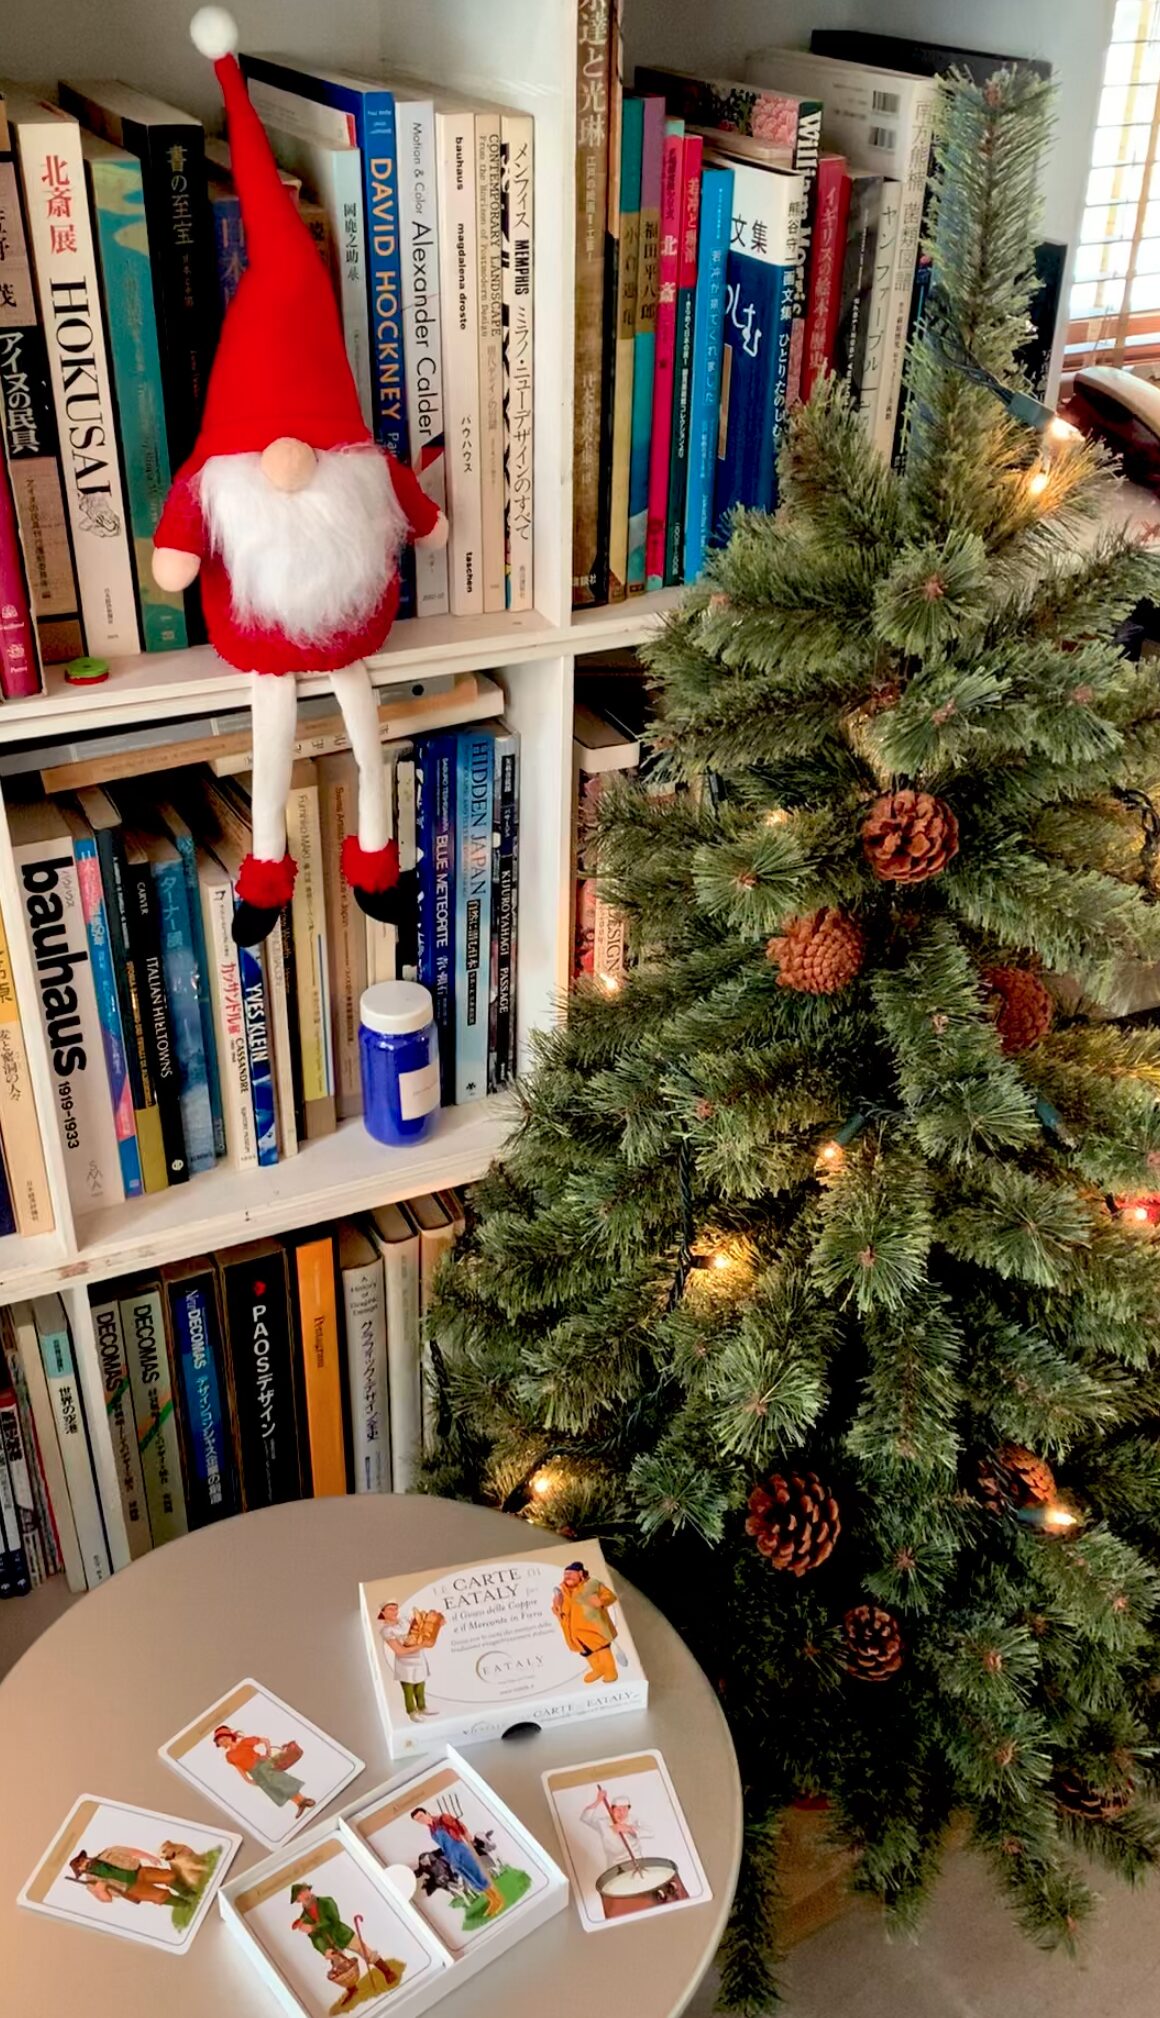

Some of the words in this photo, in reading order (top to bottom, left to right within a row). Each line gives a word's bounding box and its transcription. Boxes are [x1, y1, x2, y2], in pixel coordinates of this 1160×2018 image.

[412, 122, 423, 165] Motion
[414, 170, 425, 178] &
[456, 136, 464, 190] bauhaus
[41, 155, 77, 254] 北斎展
[167, 144, 195, 245] 書の至宝
[370, 158, 395, 256] DAVID
[413, 181, 424, 214] Color
[489, 134, 501, 248] CONTEMPORARY
[514, 143, 530, 229] メンフィス
[412, 220, 436, 347] Alexander
[457, 223, 467, 290] magdalena
[514, 240, 530, 296] MEMPHIS
[490, 255, 501, 336] LANDSCAPE
[375, 271, 401, 420] HOCKNEY
[0, 331, 39, 453] アイヌの民具
[50, 276, 112, 498] HOKUSAI
[417, 356, 438, 436] Calder
[773, 333, 790, 437] ひとりたのしむ
[461, 416, 473, 473] バウハウス
[465, 551, 474, 594] taschen
[470, 742, 488, 827] HIDDEN
[436, 834, 450, 873] BLUE
[470, 834, 488, 896] JAPAN
[436, 874, 450, 948] METEORITE
[21, 856, 88, 1077] bauhaus
[58, 1080, 80, 1150] 1919-1933
[146, 957, 163, 1003] ITALIAN
[245, 982, 265, 1013] YVES
[500, 967, 510, 1014] PASSAGE
[234, 1037, 250, 1093] CASSANDRE
[248, 1015, 269, 1063] KLEIN
[96, 1311, 122, 1393] DECOMAS
[134, 1304, 160, 1384] DECOMAS
[188, 1308, 207, 1370] DECOMAS
[58, 1386, 78, 1434] 世界の空港
[443, 1584, 520, 1610] EATALY
[453, 1569, 522, 1592] CARTE
[482, 1655, 544, 1676] EATALY
[532, 1703, 574, 1719] CARTE
[586, 1691, 634, 1708] EATALY
